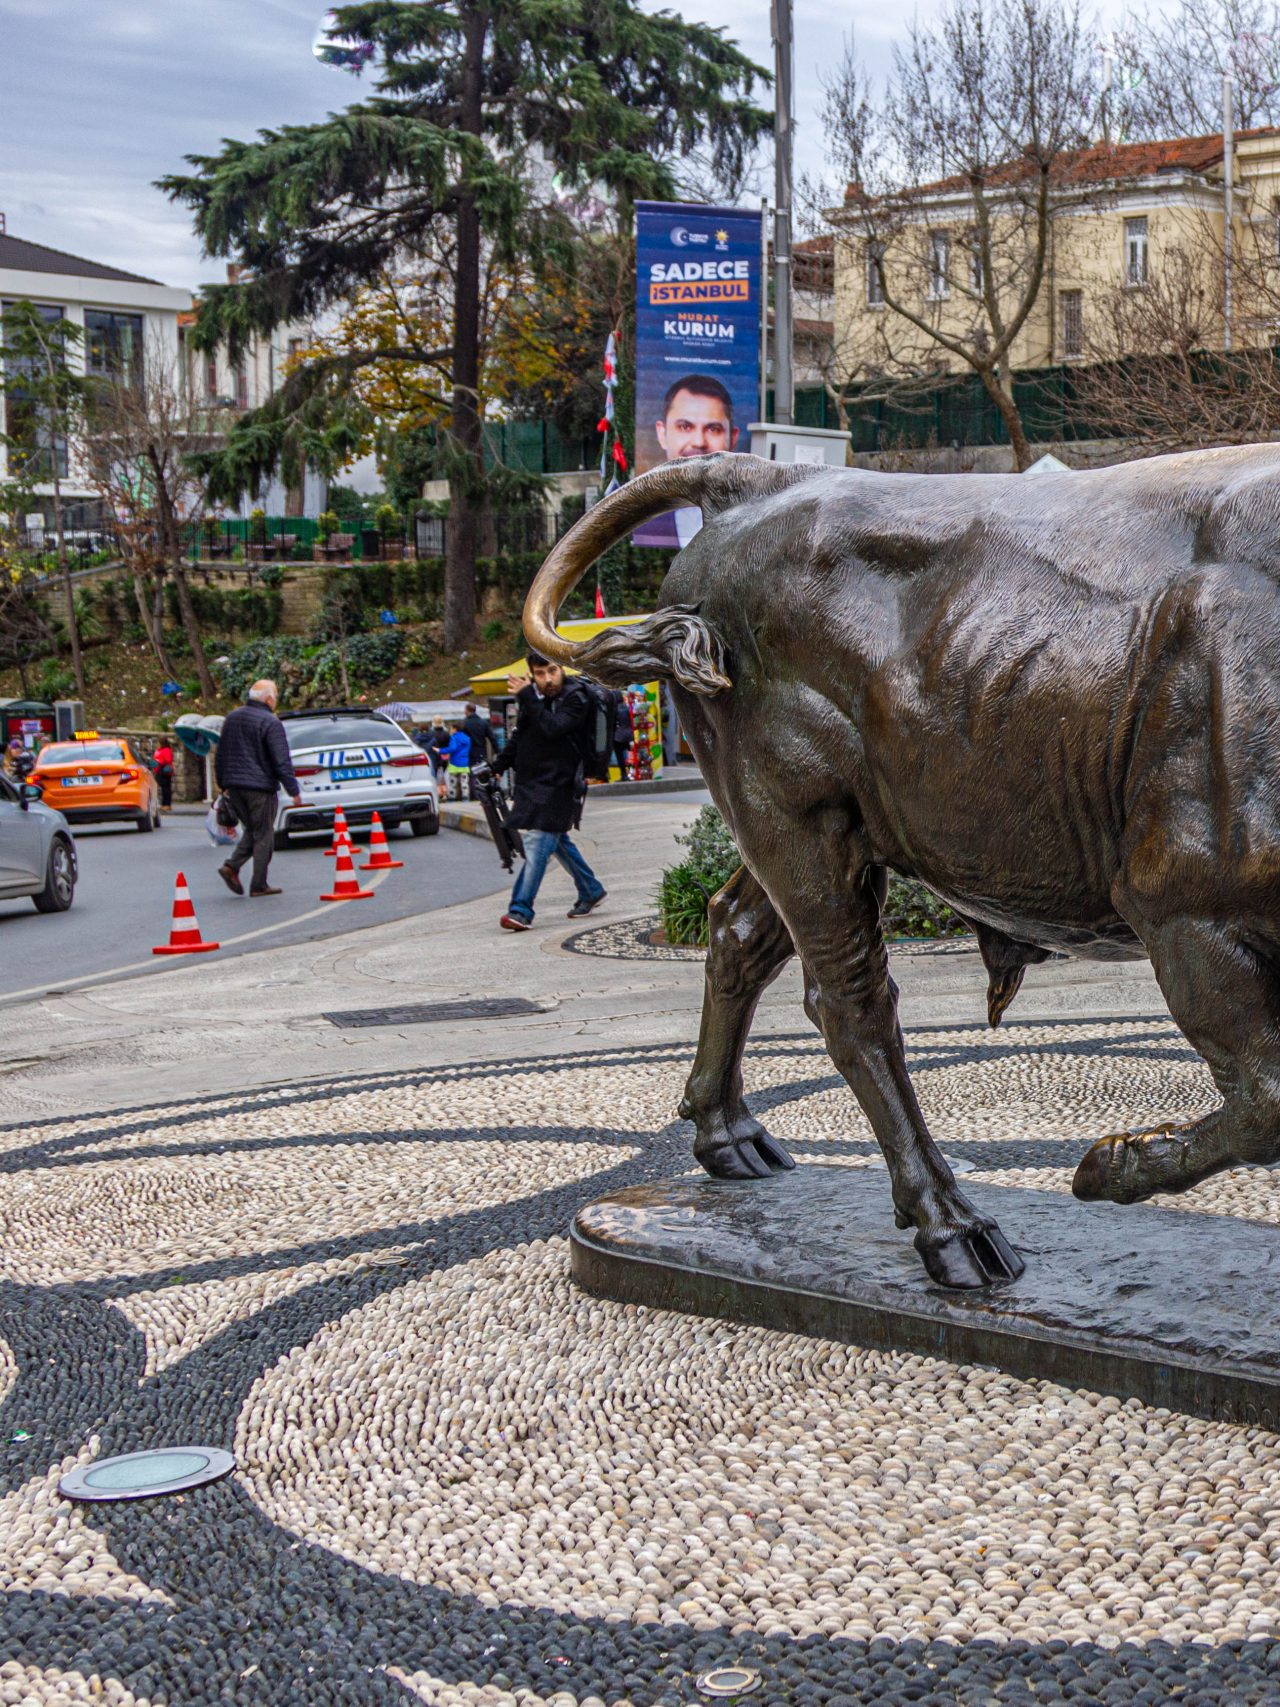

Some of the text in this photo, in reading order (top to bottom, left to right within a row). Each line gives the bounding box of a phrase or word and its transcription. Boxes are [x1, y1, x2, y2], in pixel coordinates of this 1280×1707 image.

[650, 260, 749, 282] SADECE
[677, 313, 720, 322] MURAT
[664, 320, 735, 338] KURUM
